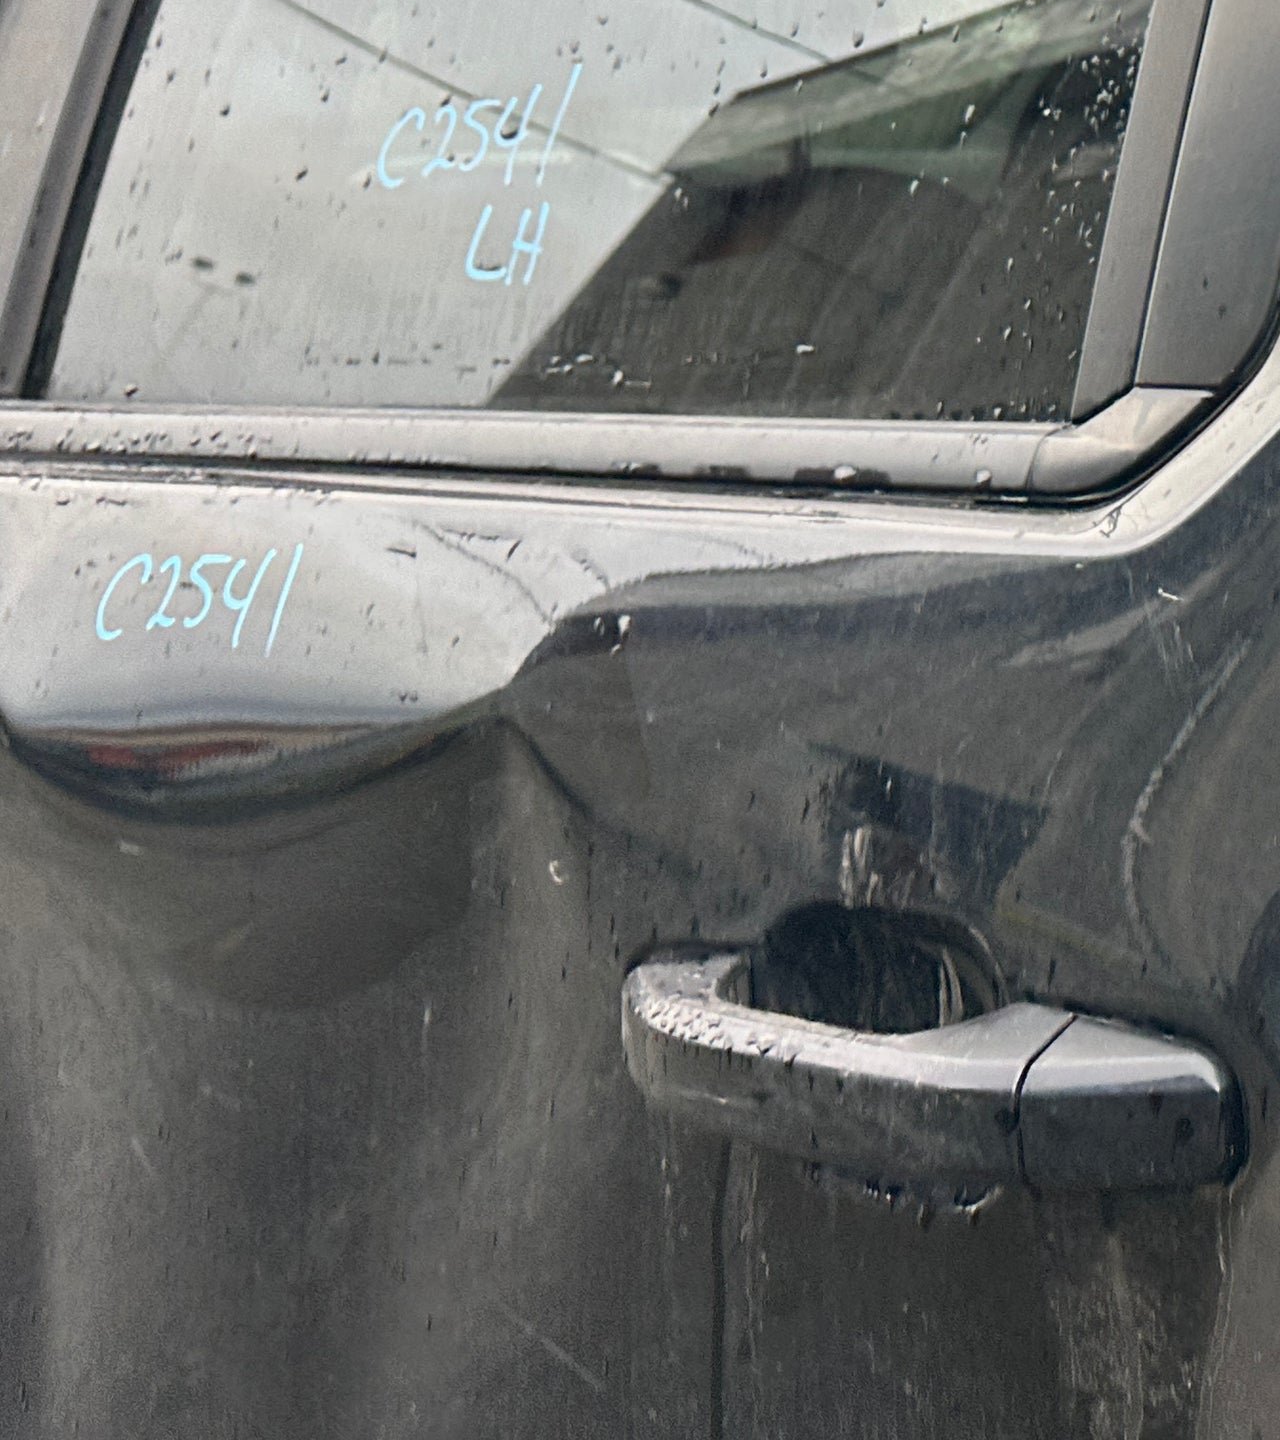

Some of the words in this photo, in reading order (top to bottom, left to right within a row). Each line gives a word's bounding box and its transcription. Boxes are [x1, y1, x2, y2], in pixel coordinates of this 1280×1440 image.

[376, 62, 583, 189] C2541
[463, 201, 550, 287] LH
[95, 543, 304, 659] C2541
